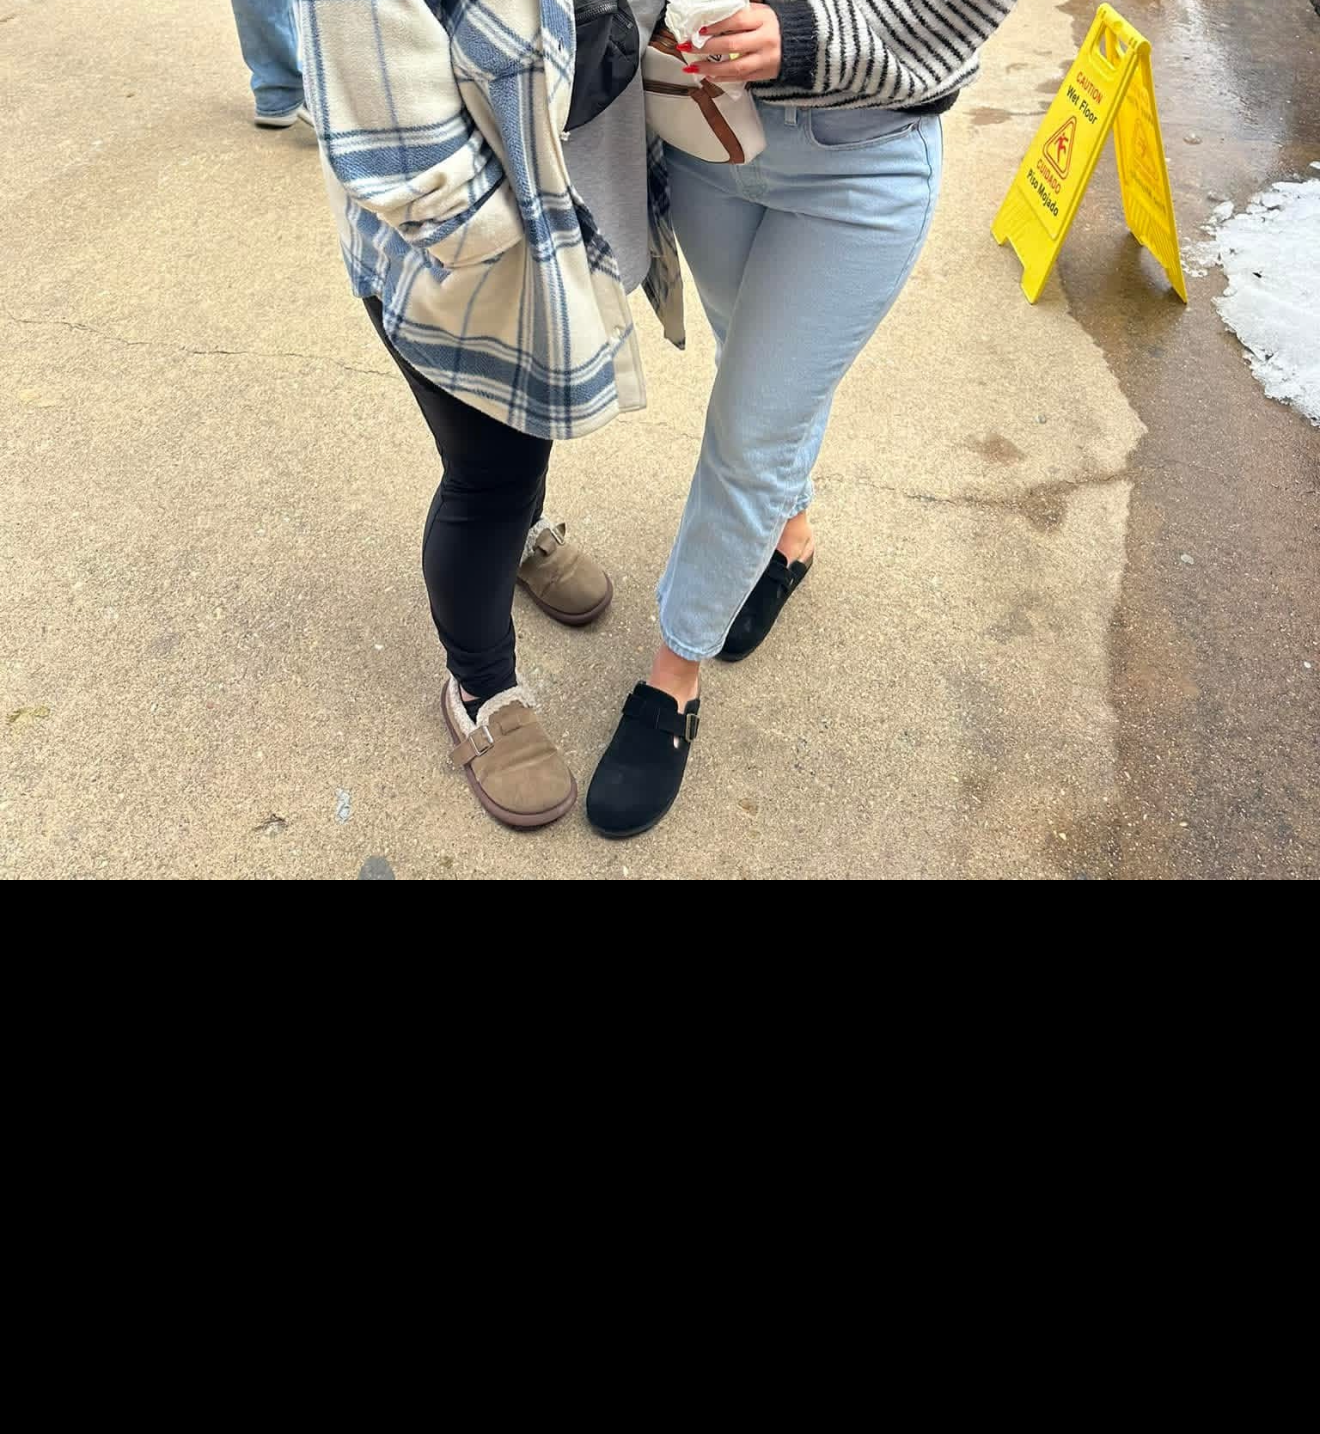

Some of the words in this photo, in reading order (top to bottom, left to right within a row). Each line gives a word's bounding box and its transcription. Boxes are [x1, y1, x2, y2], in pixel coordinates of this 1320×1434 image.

[1066, 84, 1080, 106] Wet
[1079, 101, 1098, 125] Floor
[1076, 71, 1103, 105] CAUTION
[1026, 169, 1038, 189] Piso
[1037, 183, 1059, 217] Mojado
[1036, 158, 1062, 195] CUIDADO
